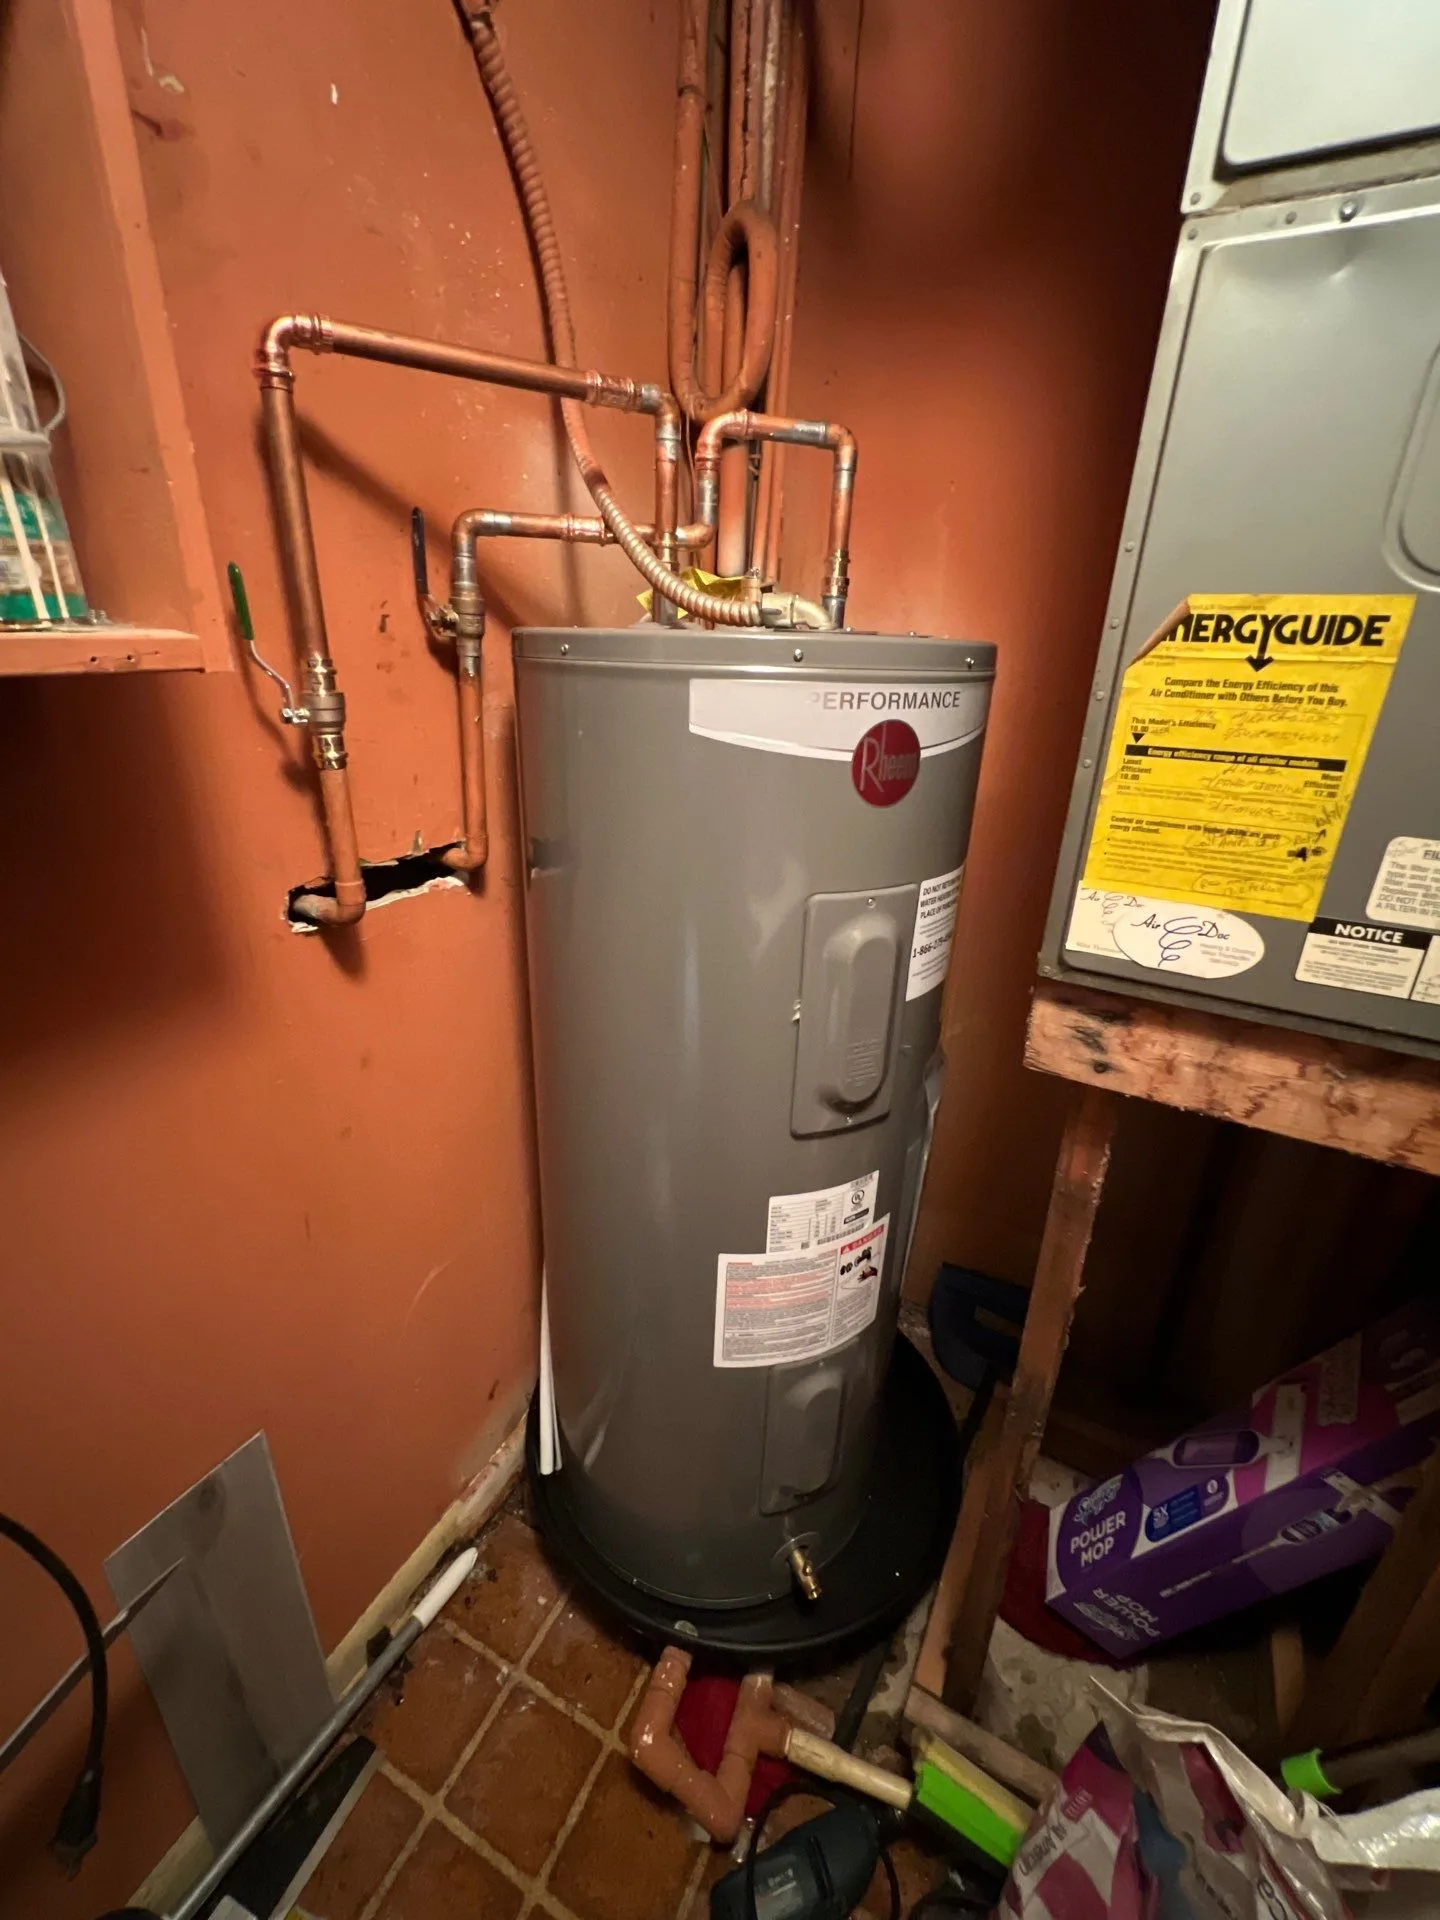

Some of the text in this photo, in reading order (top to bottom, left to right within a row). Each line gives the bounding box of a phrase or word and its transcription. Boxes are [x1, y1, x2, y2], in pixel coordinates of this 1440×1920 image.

[1161, 614, 1391, 650] NERGYGUIDE
[1164, 677, 1339, 694] Compare the Energy Efficiency of this
[808, 691, 961, 710] PERFORMANCE
[1149, 689, 1348, 708] Air Conditioner with Others Before You Buy.
[1178, 719, 1216, 730] Efficiency
[1147, 748, 1173, 759] Energy
[1173, 750, 1212, 762] efficiency
[1131, 913, 1230, 941] Air Doc
[1334, 923, 1404, 944] NOTICE
[1070, 1510, 1127, 1555] POWER
[1080, 1535, 1115, 1568] MOP
[1092, 1587, 1161, 1638] POWER
